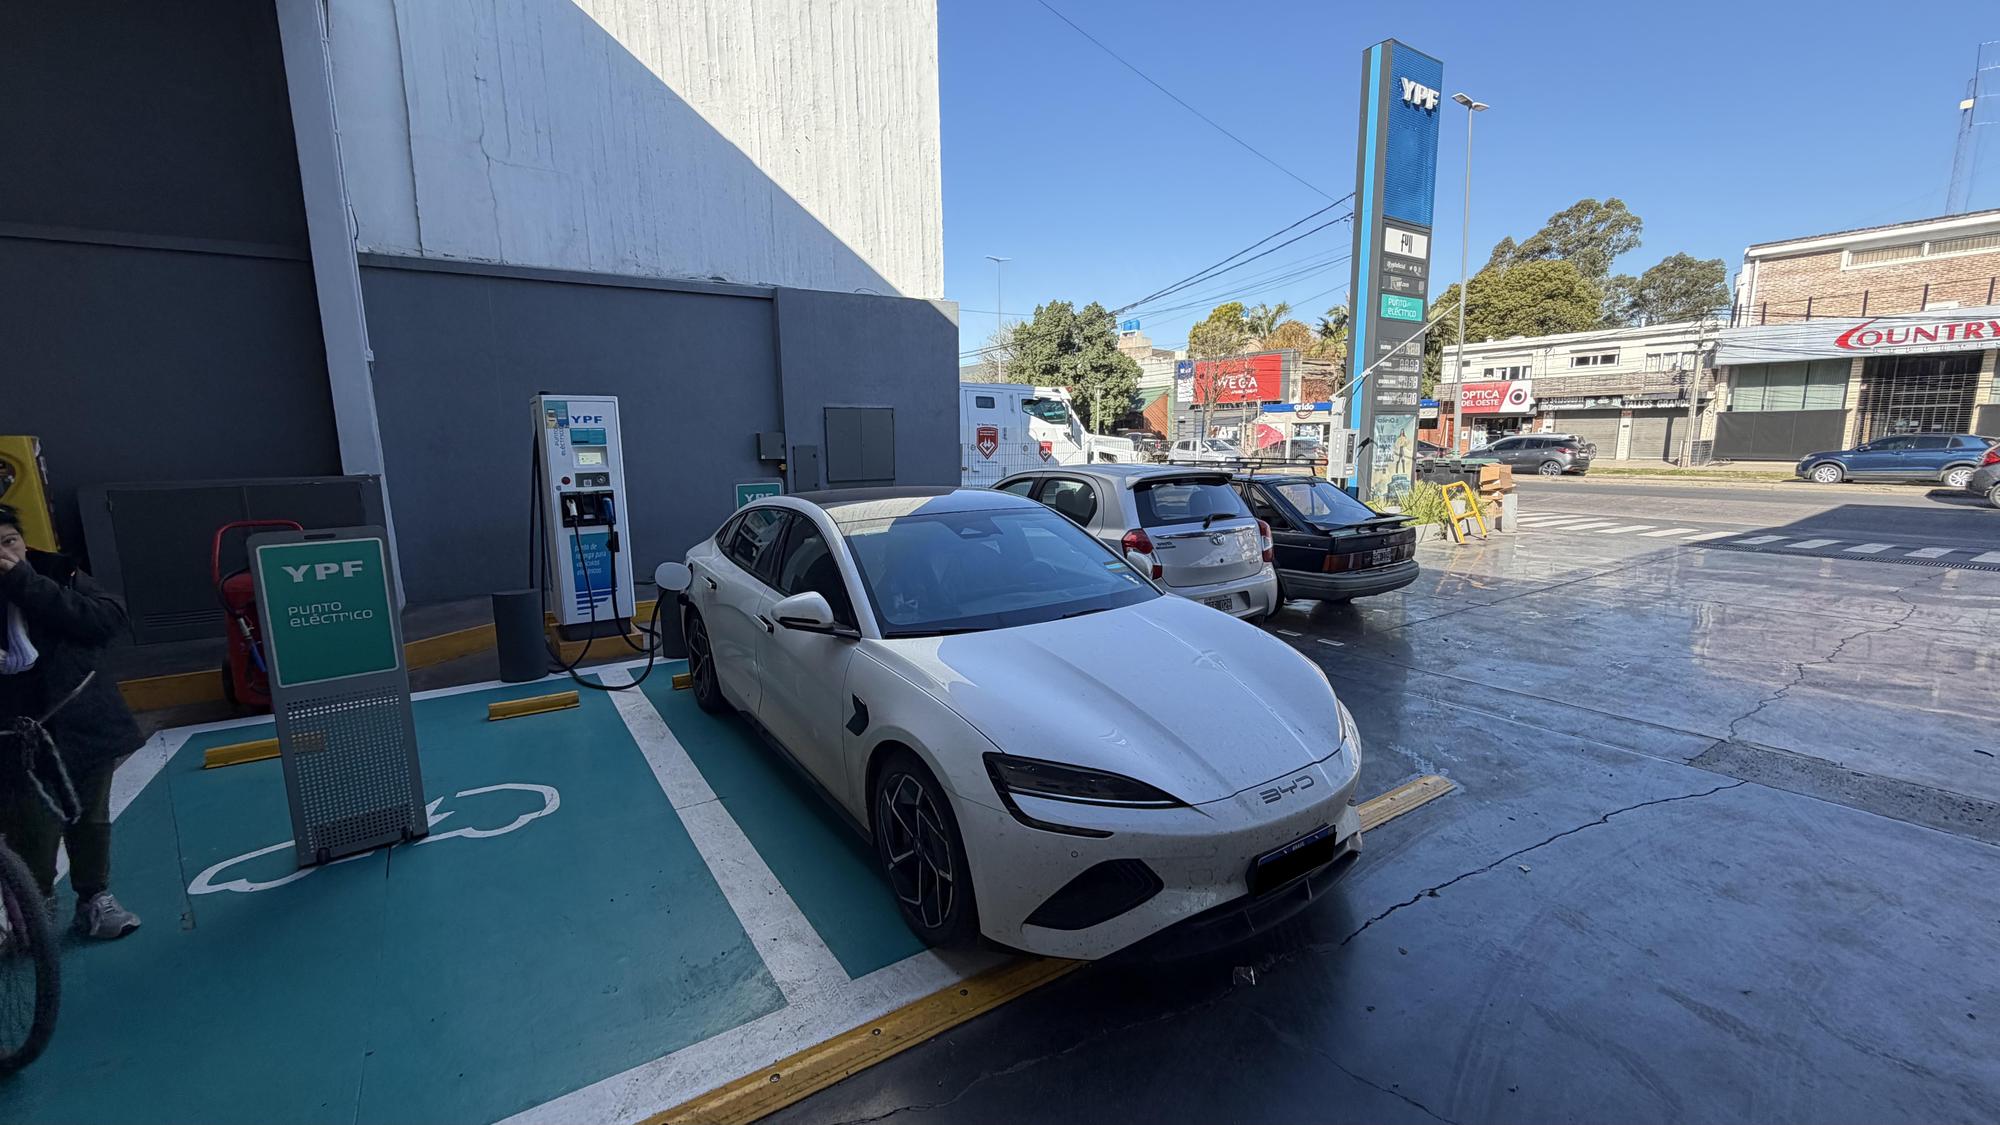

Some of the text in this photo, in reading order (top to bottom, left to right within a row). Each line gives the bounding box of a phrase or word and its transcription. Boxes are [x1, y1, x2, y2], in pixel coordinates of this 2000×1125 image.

[1401, 77, 1440, 109] YPF
[1834, 318, 2000, 350] COUNTRY
[1217, 377, 1258, 389] WEGA
[1461, 390, 1500, 400] OPTICA
[1624, 401, 1653, 409] TALLES
[1657, 399, 1692, 408] GRANDE
[571, 415, 603, 424] YPF
[281, 560, 363, 583] YPF
[1259, 774, 1315, 804] BYD
